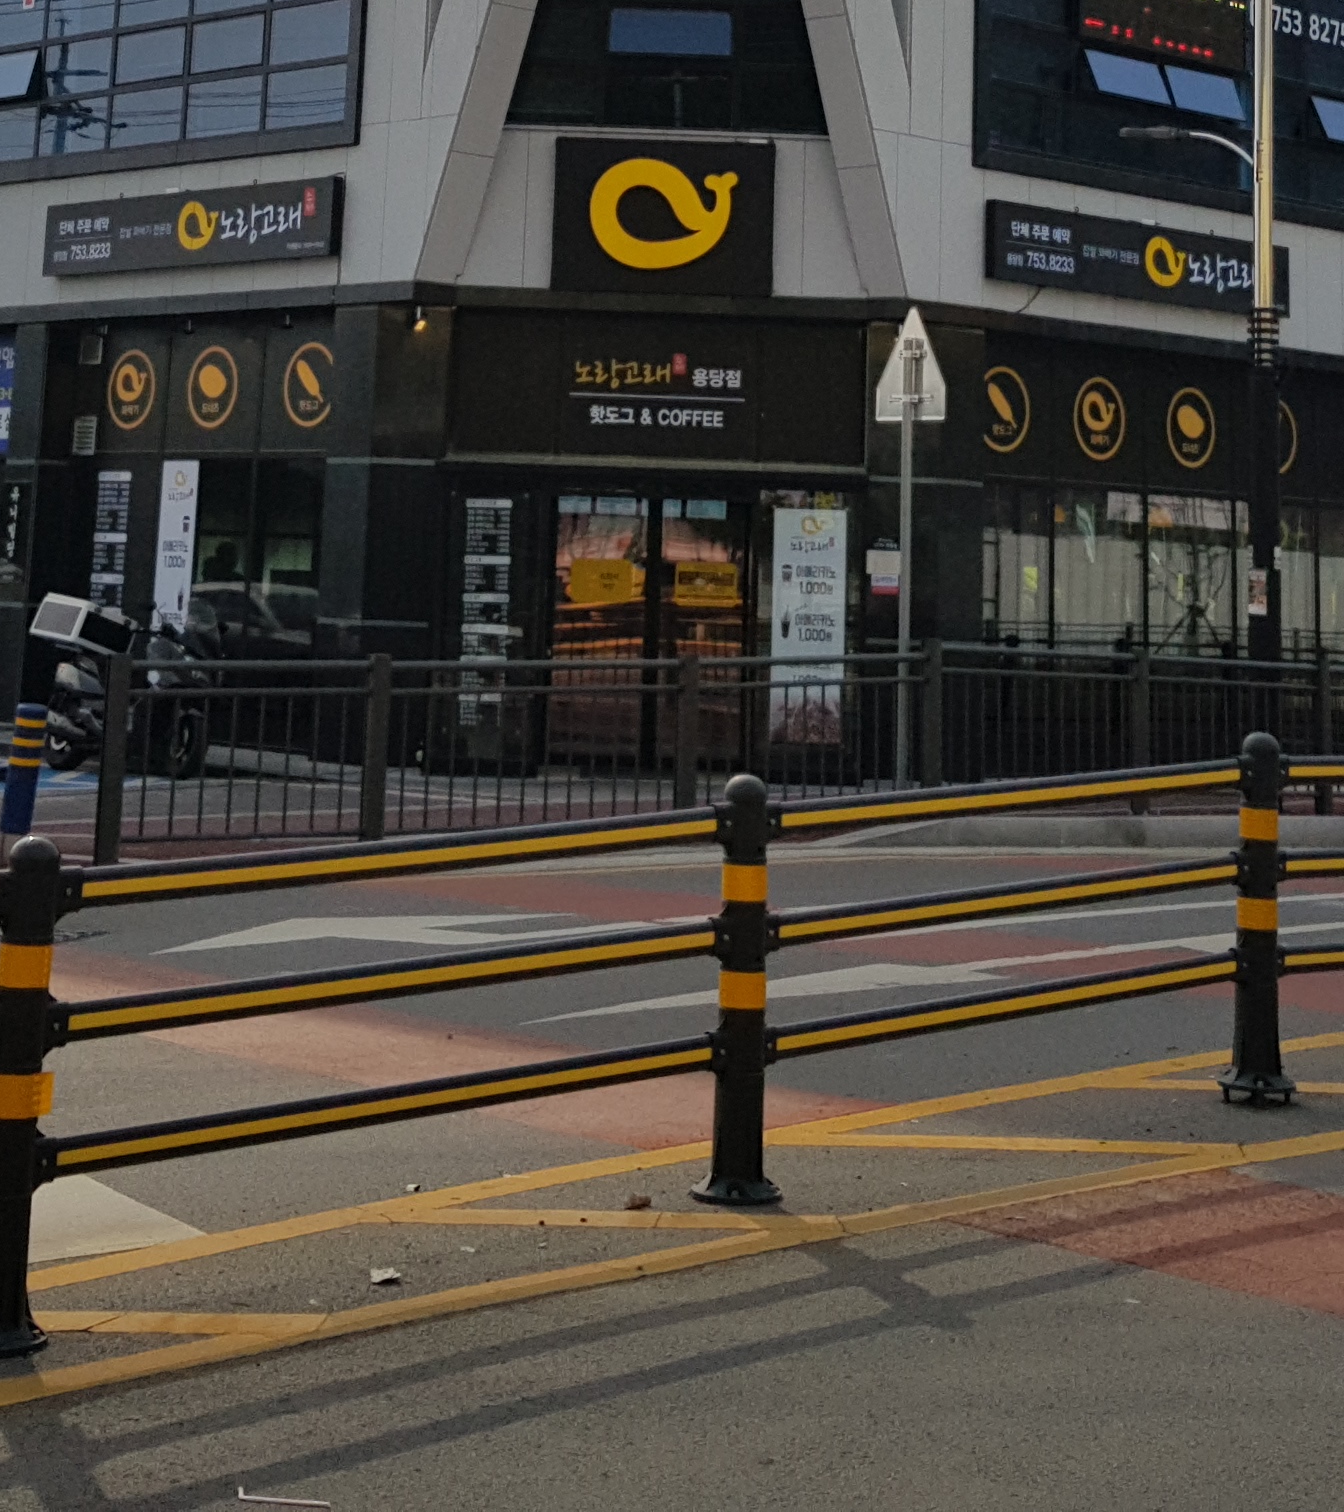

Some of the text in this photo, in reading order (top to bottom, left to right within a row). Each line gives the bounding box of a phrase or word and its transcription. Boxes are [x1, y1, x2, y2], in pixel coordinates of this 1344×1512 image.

[221, 202, 303, 244] 노랑고래
[575, 358, 672, 389] 노랑고래
[692, 367, 742, 389] 용당점
[589, 404, 724, 428] 핫도그 & COFFEE
